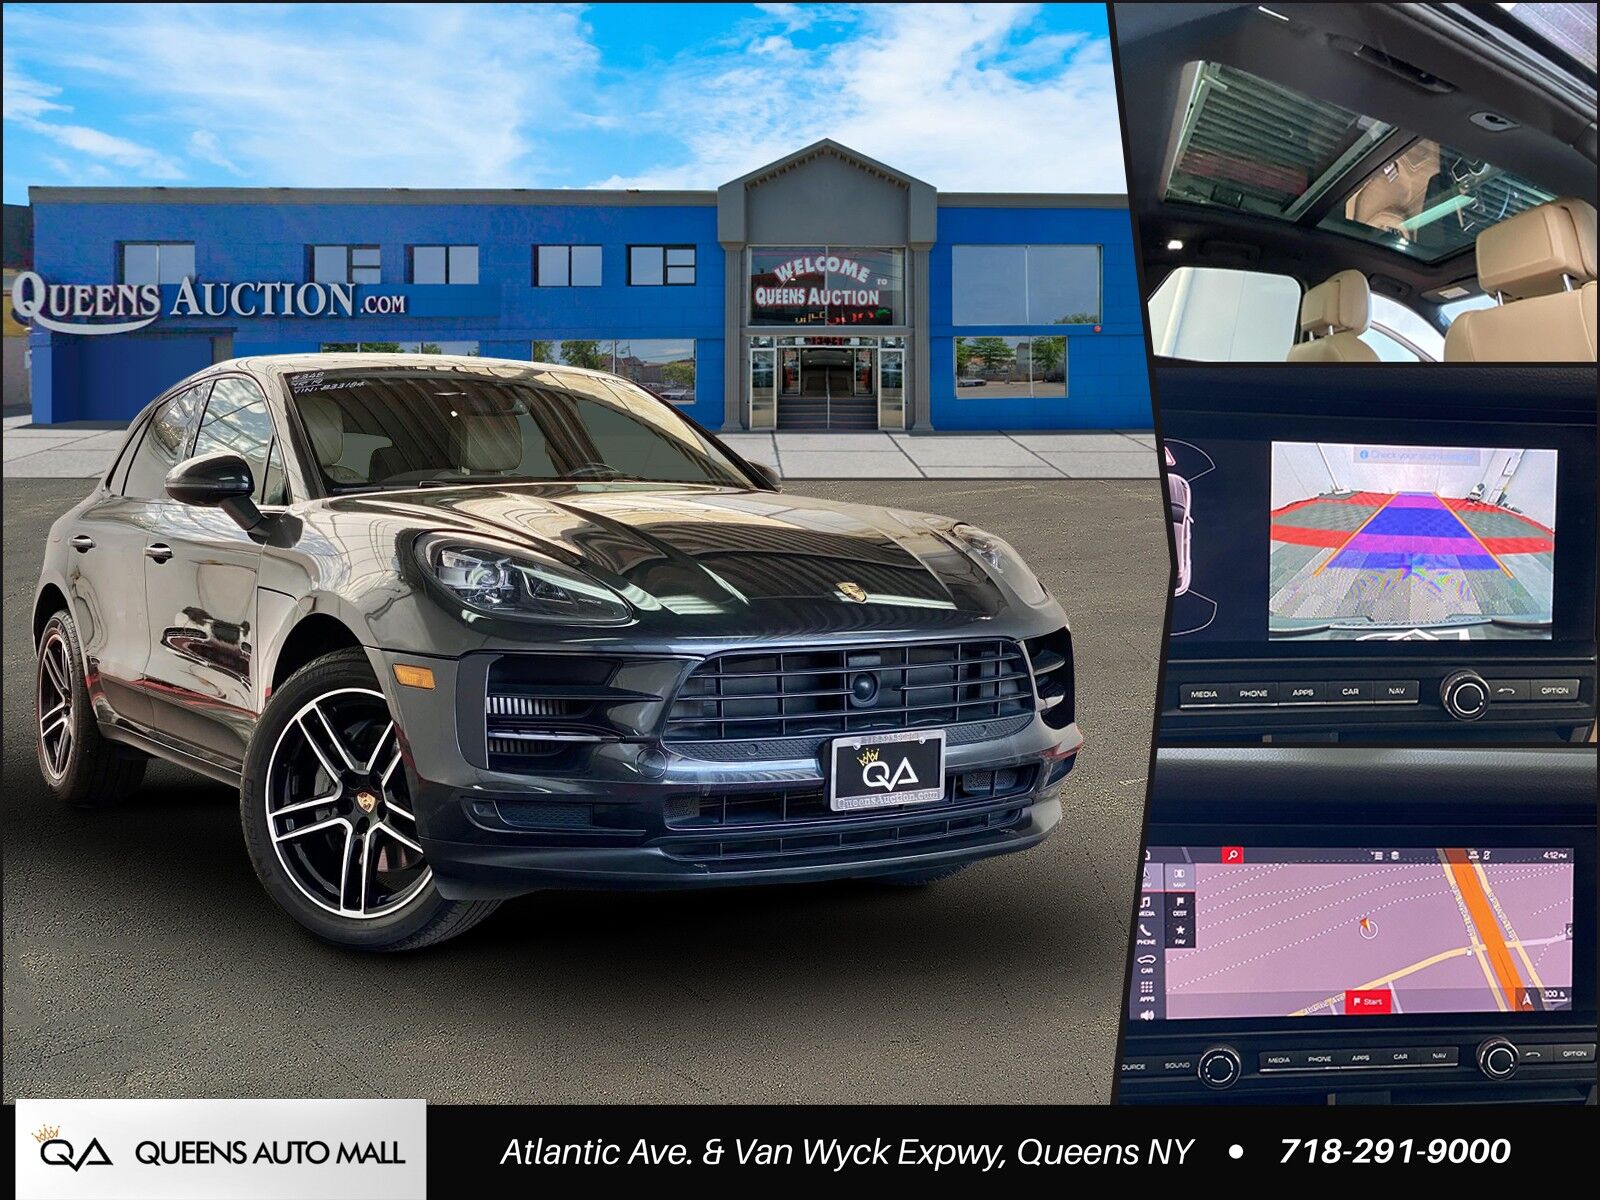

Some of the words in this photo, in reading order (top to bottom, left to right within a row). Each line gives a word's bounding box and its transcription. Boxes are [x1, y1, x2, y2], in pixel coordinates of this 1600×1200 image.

[774, 256, 871, 283] WELCOME
[755, 287, 805, 307] QUEENS
[808, 288, 880, 306] AUCTION
[12, 271, 161, 335] QUEENS
[1191, 690, 1218, 698] MEDIA
[1239, 689, 1268, 697] PHONE
[1292, 688, 1314, 697] APPS
[1342, 687, 1359, 696] CAR
[1388, 687, 1406, 695] NAV
[1541, 687, 1570, 695] OPTION
[862, 756, 919, 792] QA
[837, 790, 939, 809] QueensAuction.com
[1544, 989, 1558, 998] 100
[1363, 997, 1383, 1006] Start
[1351, 1053, 1371, 1062] APPS
[1393, 1052, 1409, 1061] CAR
[1432, 1052, 1448, 1060] NAV
[1562, 1050, 1588, 1058] OPTION
[1267, 1056, 1291, 1065] MEDIA
[1307, 1055, 1332, 1063] PHONE
[1164, 1061, 1191, 1070] SOUND
